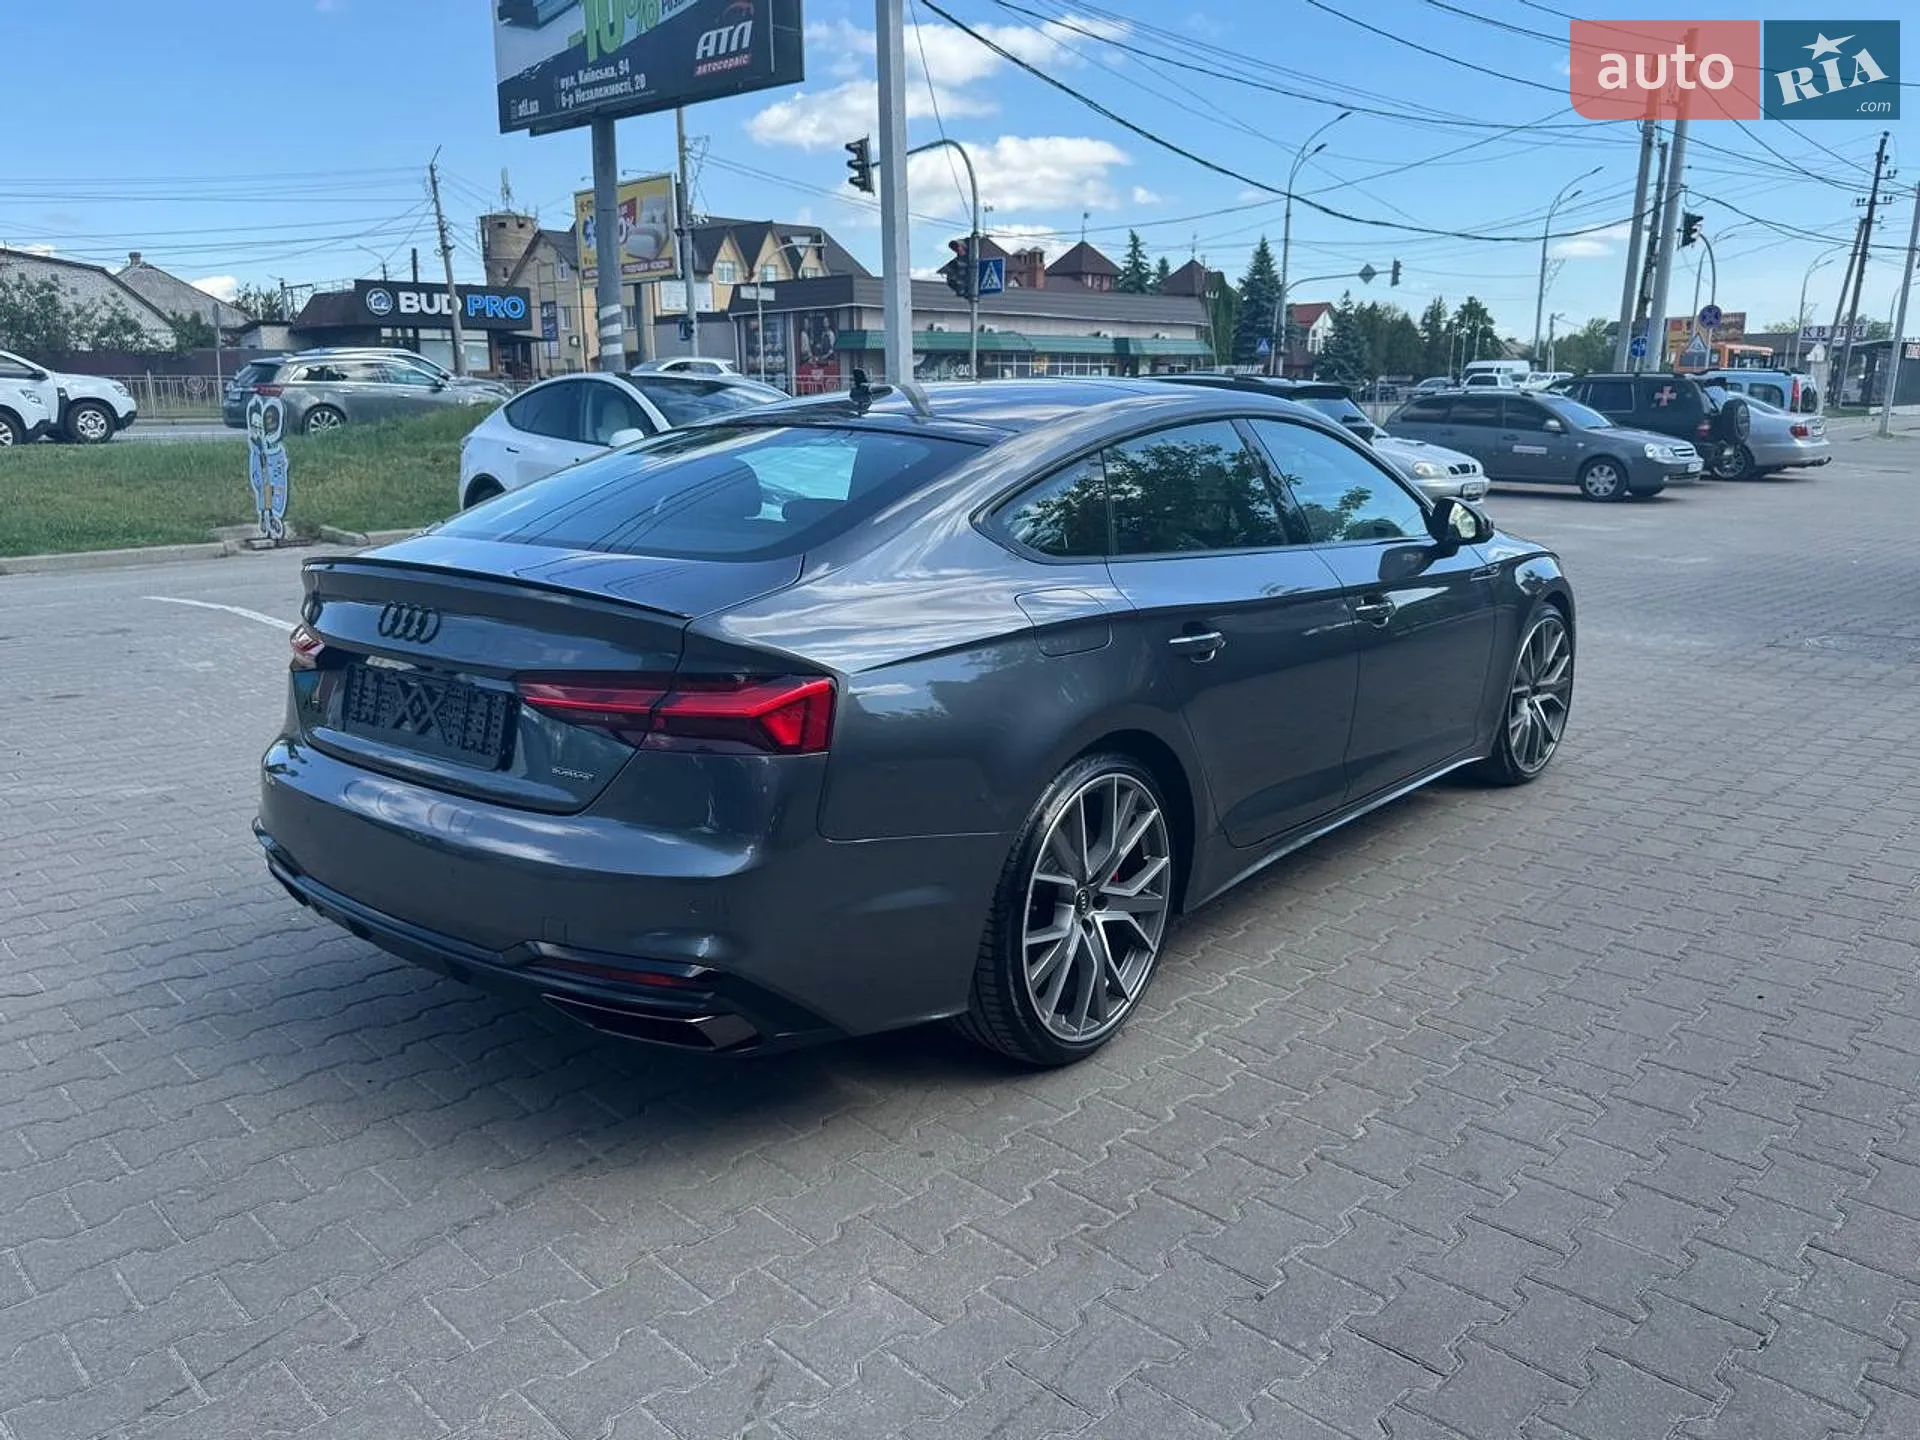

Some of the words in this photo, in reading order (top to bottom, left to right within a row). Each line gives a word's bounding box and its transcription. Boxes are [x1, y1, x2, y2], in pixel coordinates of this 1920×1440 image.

[398, 291, 462, 315] BUD
[466, 294, 526, 319] PRO
[1801, 324, 1866, 339] КВТИ
